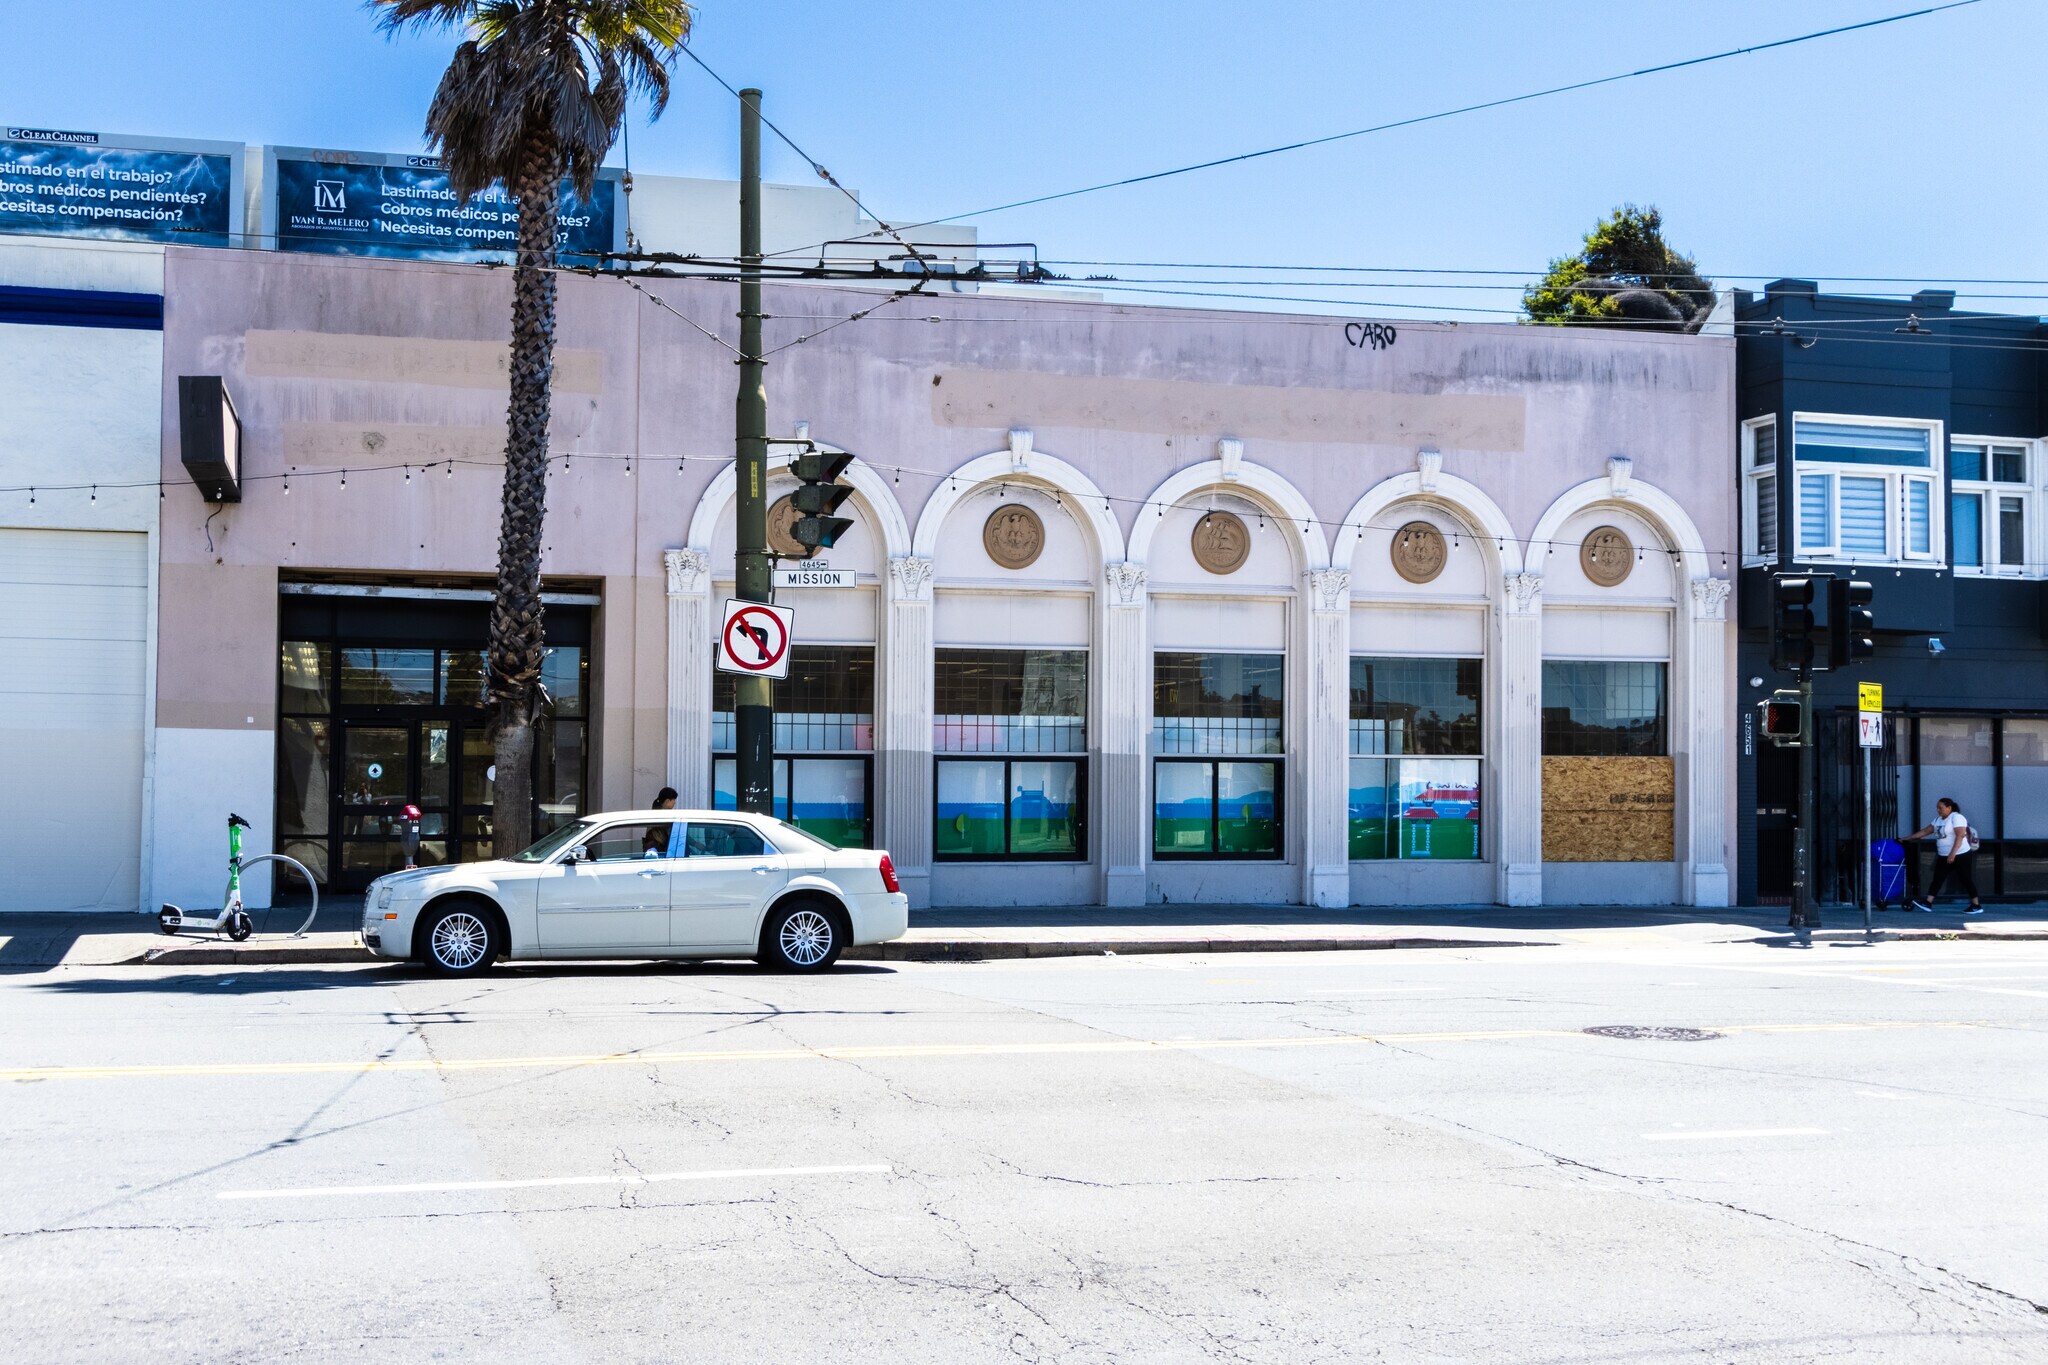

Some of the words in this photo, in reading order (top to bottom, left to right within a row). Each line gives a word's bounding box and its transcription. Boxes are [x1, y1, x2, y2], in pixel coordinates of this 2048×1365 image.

[66, 169, 87, 179] en
[90, 166, 105, 180] el
[108, 168, 173, 186] trabajo?
[38, 180, 106, 199] médicos
[110, 187, 207, 205] pendientes?
[484, 193, 497, 204] el
[58, 202, 184, 222] compensación?
[291, 215, 315, 225] IVAN
[317, 217, 327, 226] R.
[328, 218, 370, 228] MELERO
[381, 203, 433, 217] Cobros
[436, 206, 498, 222] médicos
[381, 221, 452, 236] Necesitas
[1345, 322, 1397, 350] CARO
[788, 573, 840, 584] MISSION
